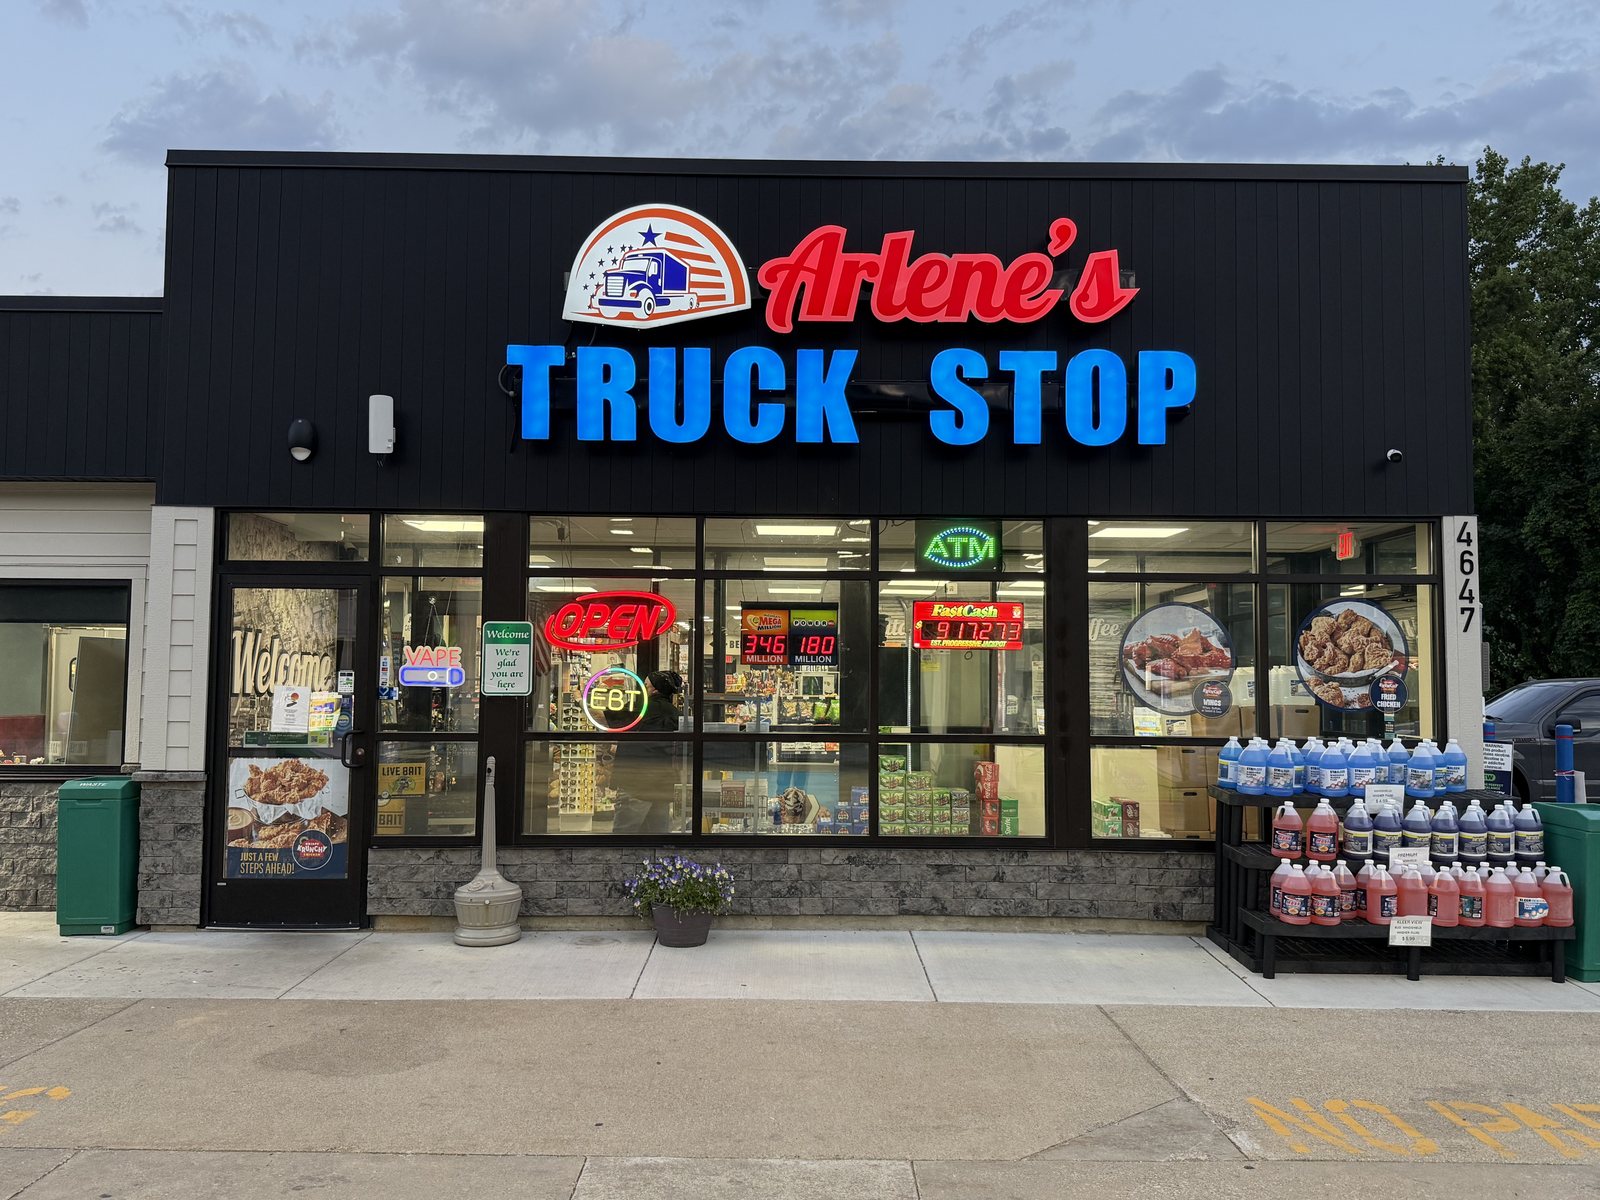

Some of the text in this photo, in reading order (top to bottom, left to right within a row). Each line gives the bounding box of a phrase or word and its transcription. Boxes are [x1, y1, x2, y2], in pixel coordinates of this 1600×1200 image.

[758, 218, 1140, 333] Arlene's
[507, 345, 1197, 446] TRUCK STOP
[924, 536, 996, 558] ATM
[1456, 521, 1475, 633] 4647
[553, 603, 662, 640] OPEN
[759, 616, 782, 625] MEGA
[486, 629, 530, 639] Welcome
[744, 635, 835, 655] 346 180
[942, 640, 982, 648] PROGRESSIVE
[982, 640, 1008, 648] JACKPOT
[404, 647, 461, 667] VAPE
[495, 648, 520, 657] We're
[746, 654, 832, 663] MILLION MILLION
[230, 626, 334, 698] Welcome
[497, 658, 516, 669] glad
[490, 670, 509, 680] you
[497, 680, 516, 688] here
[589, 687, 641, 712] EBT
[1376, 700, 1401, 708] CHICKEN
[382, 766, 423, 776] LIVE BAIT
[378, 814, 404, 826] BAIT
[1004, 817, 1012, 835] Sprite
[296, 844, 328, 853] KRUNCHY
[240, 852, 279, 862] JUST A FEW
[240, 862, 295, 875] STEPS AHEAD!
[1246, 1097, 1438, 1157] NO
